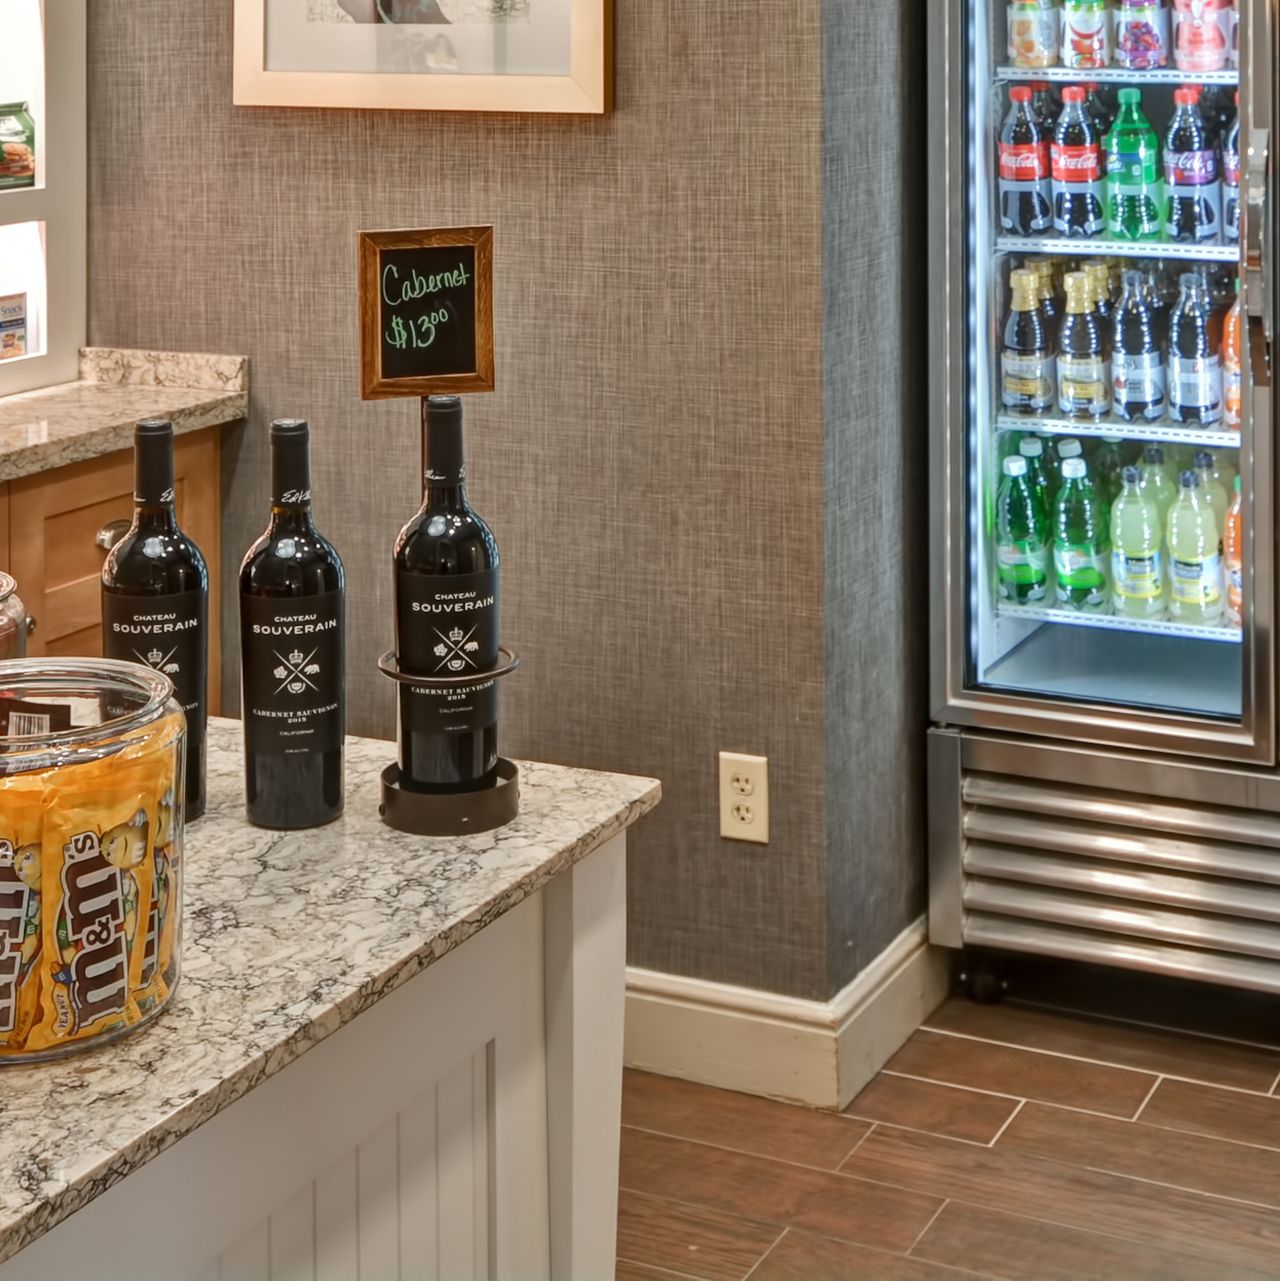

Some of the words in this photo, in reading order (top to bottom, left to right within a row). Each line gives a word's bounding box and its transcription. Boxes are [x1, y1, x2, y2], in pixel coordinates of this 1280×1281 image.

[382, 263, 470, 306] Cabernet
[434, 591, 477, 601] CHATEAU
[411, 596, 494, 613] SOUVERAIN
[133, 612, 177, 622] CHATEAU
[273, 613, 317, 623] CHATEAU
[112, 618, 198, 634] SOUVERAIN
[253, 618, 337, 636] SOUVERAIN
[411, 686, 453, 696] CABERNET
[252, 708, 294, 718] CABERNET
[296, 702, 338, 717] SAUVIGNON
